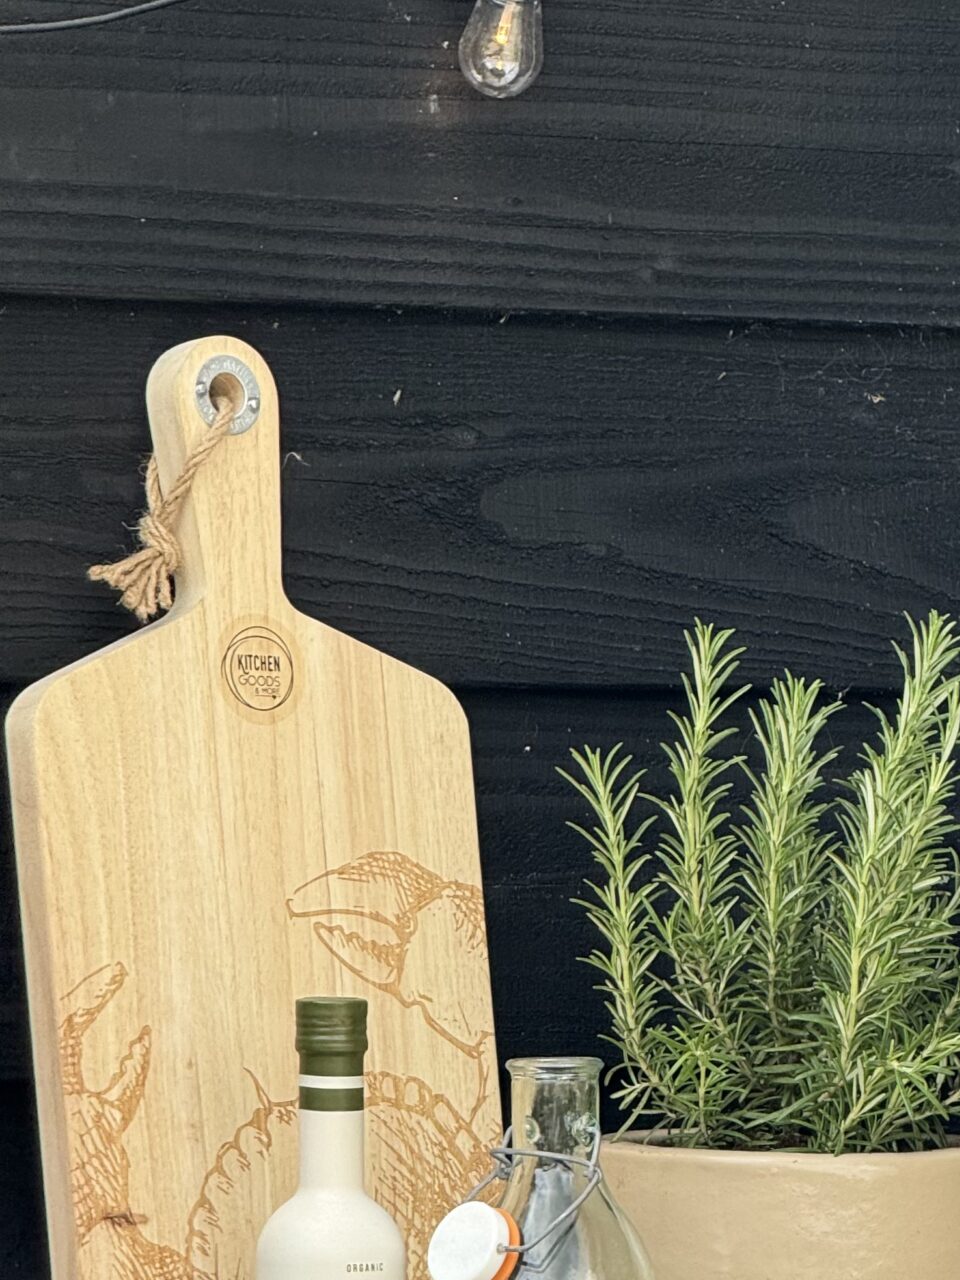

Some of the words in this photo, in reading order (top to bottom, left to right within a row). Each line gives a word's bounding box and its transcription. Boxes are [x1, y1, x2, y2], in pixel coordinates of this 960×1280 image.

[237, 654, 280, 675] KITCHEN
[239, 675, 281, 687] GOODS
[346, 1262, 384, 1272] ORGANIC
